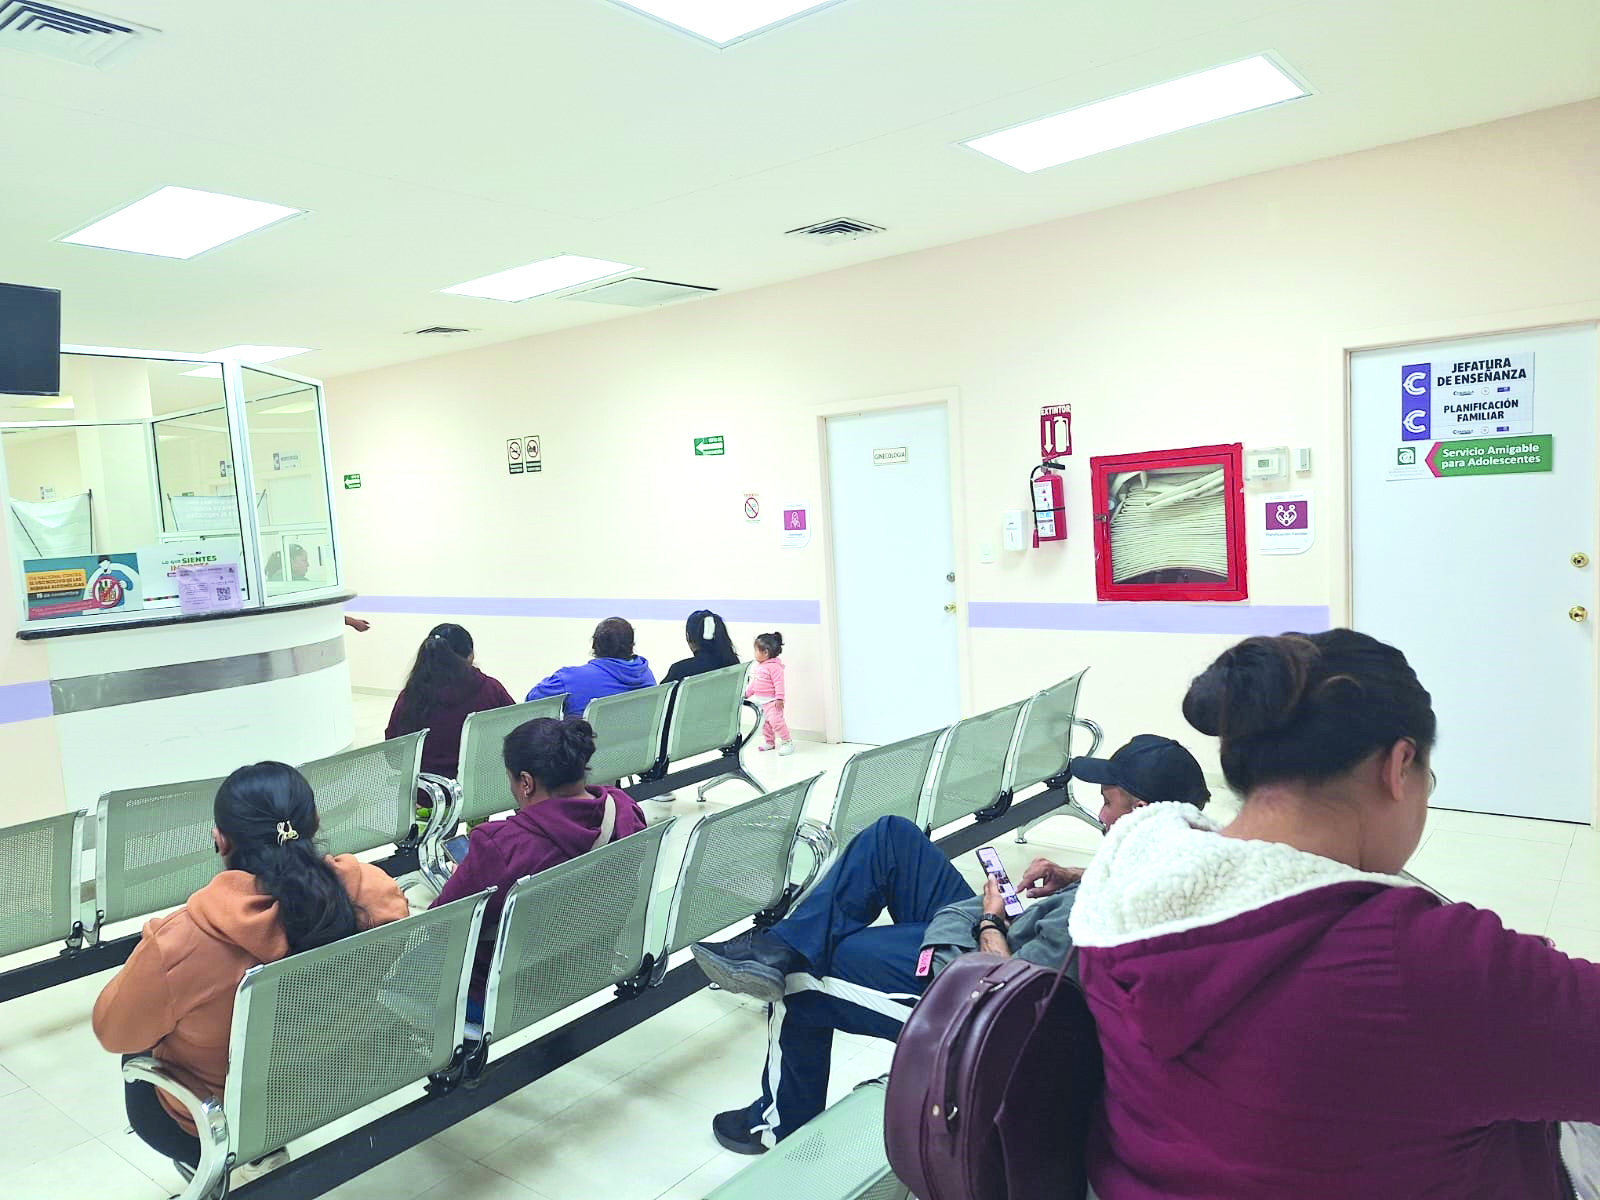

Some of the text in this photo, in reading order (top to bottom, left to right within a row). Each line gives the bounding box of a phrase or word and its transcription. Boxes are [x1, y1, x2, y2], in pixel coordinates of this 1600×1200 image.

[1451, 357, 1512, 374] JEFATURA
[1437, 368, 1527, 387] DE ENSEÑANZA
[1040, 404, 1071, 416] EXTINTOR
[1443, 397, 1519, 413] PLANIFICACIÓN
[1457, 410, 1504, 423] FAMILIAR
[1442, 443, 1540, 458] Servicio Amigable
[1441, 455, 1541, 470] para Adolescentes
[181, 555, 217, 564] SIENTES
